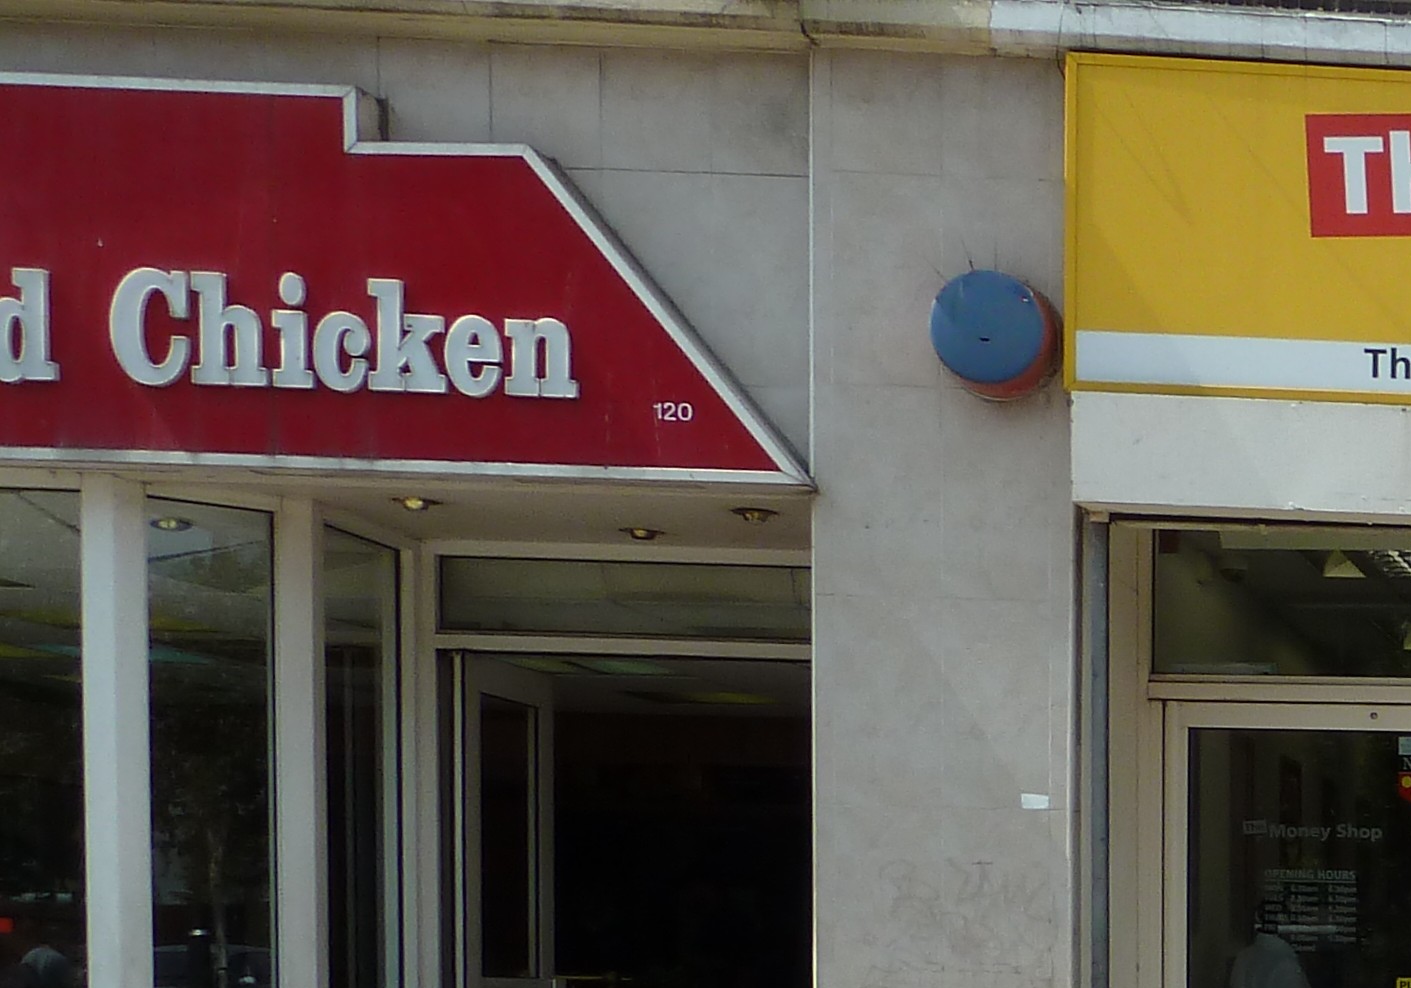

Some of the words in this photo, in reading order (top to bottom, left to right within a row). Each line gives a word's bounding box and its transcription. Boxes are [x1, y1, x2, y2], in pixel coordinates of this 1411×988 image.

[110, 267, 579, 400] Chicken
[653, 401, 694, 423] 120
[1269, 824, 1331, 841] Money
[1336, 823, 1383, 842] Shop
[1265, 869, 1313, 880] OPENING
[1317, 869, 1356, 880] HOURS
